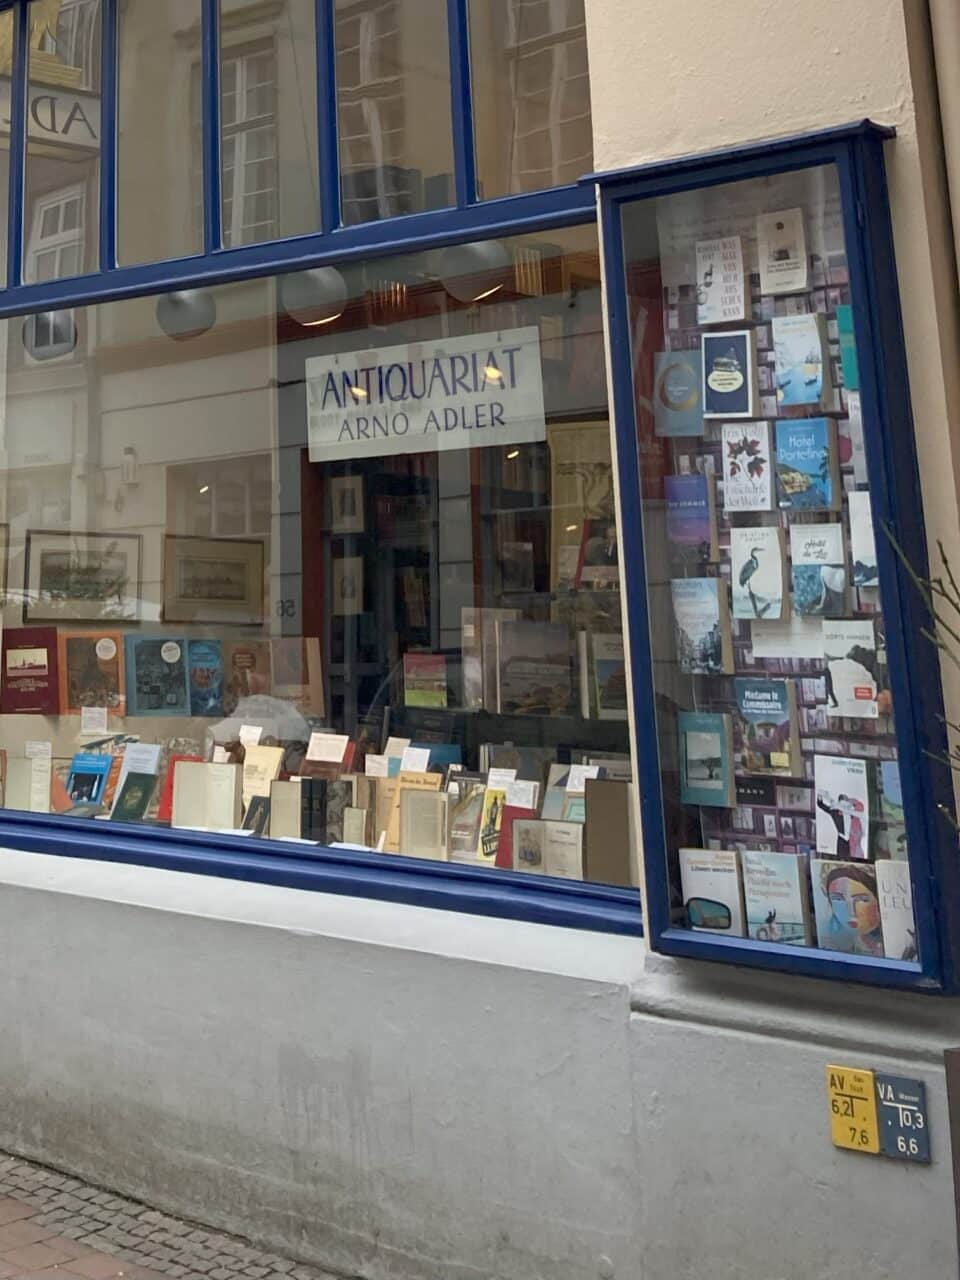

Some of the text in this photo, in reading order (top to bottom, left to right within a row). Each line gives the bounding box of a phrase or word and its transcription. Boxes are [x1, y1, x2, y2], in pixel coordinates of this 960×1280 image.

[321, 347, 522, 410] ANTIQUARIAT
[337, 402, 506, 442] ARNO ADLER
[788, 433, 815, 448] Hotel
[830, 1073, 844, 1090] AV
[877, 1082, 894, 1101] VA
[831, 1099, 850, 1117] 6,2
[849, 1127, 869, 1146] 7,6
[897, 1136, 918, 1156] 6,6
